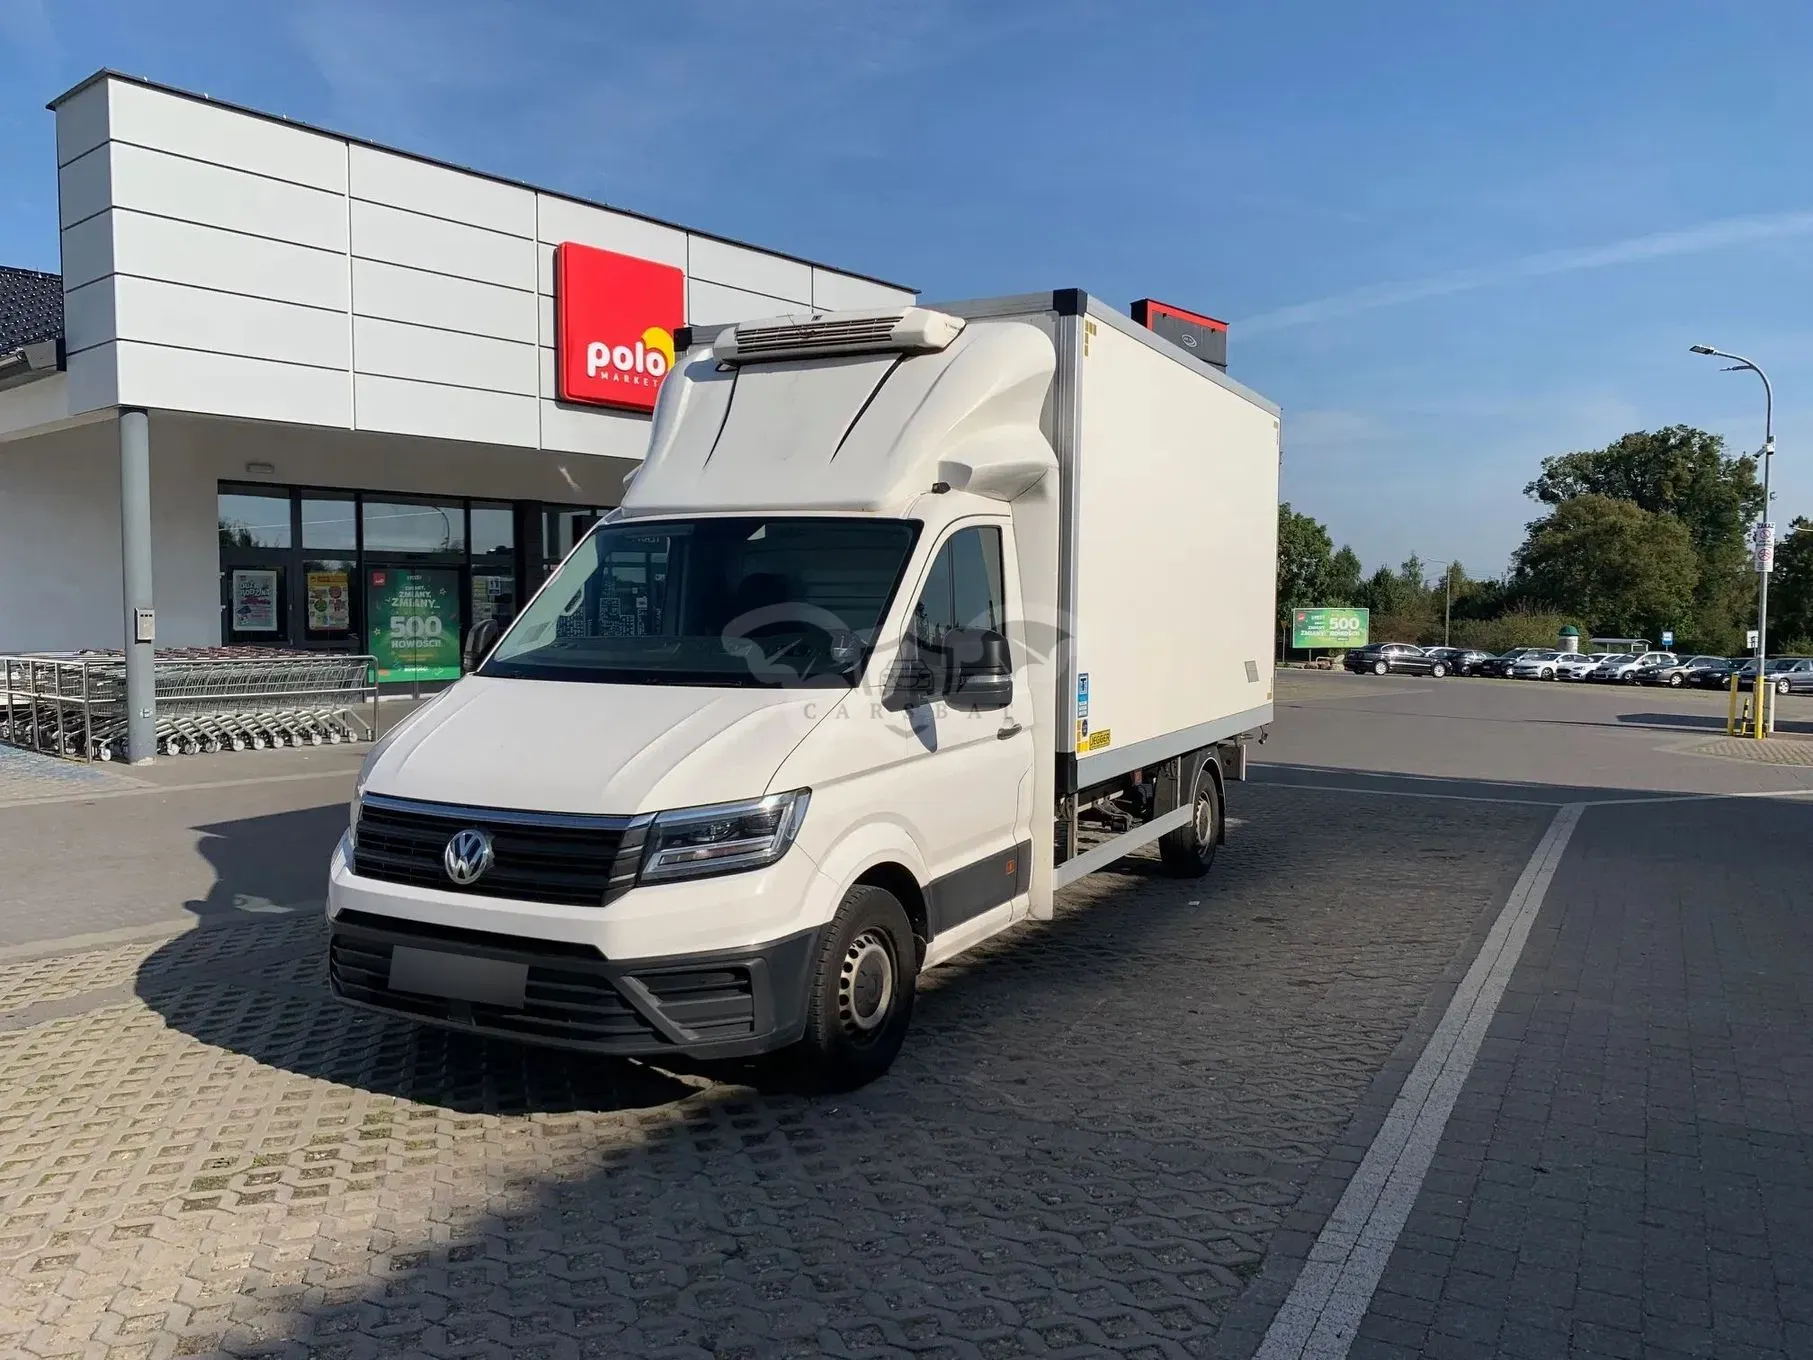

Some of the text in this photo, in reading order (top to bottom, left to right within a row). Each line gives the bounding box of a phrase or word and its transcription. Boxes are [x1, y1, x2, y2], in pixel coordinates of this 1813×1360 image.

[587, 341, 666, 377] polo
[600, 371, 659, 387] MARKET
[390, 616, 442, 637] 500
[1329, 617, 1360, 630] 500
